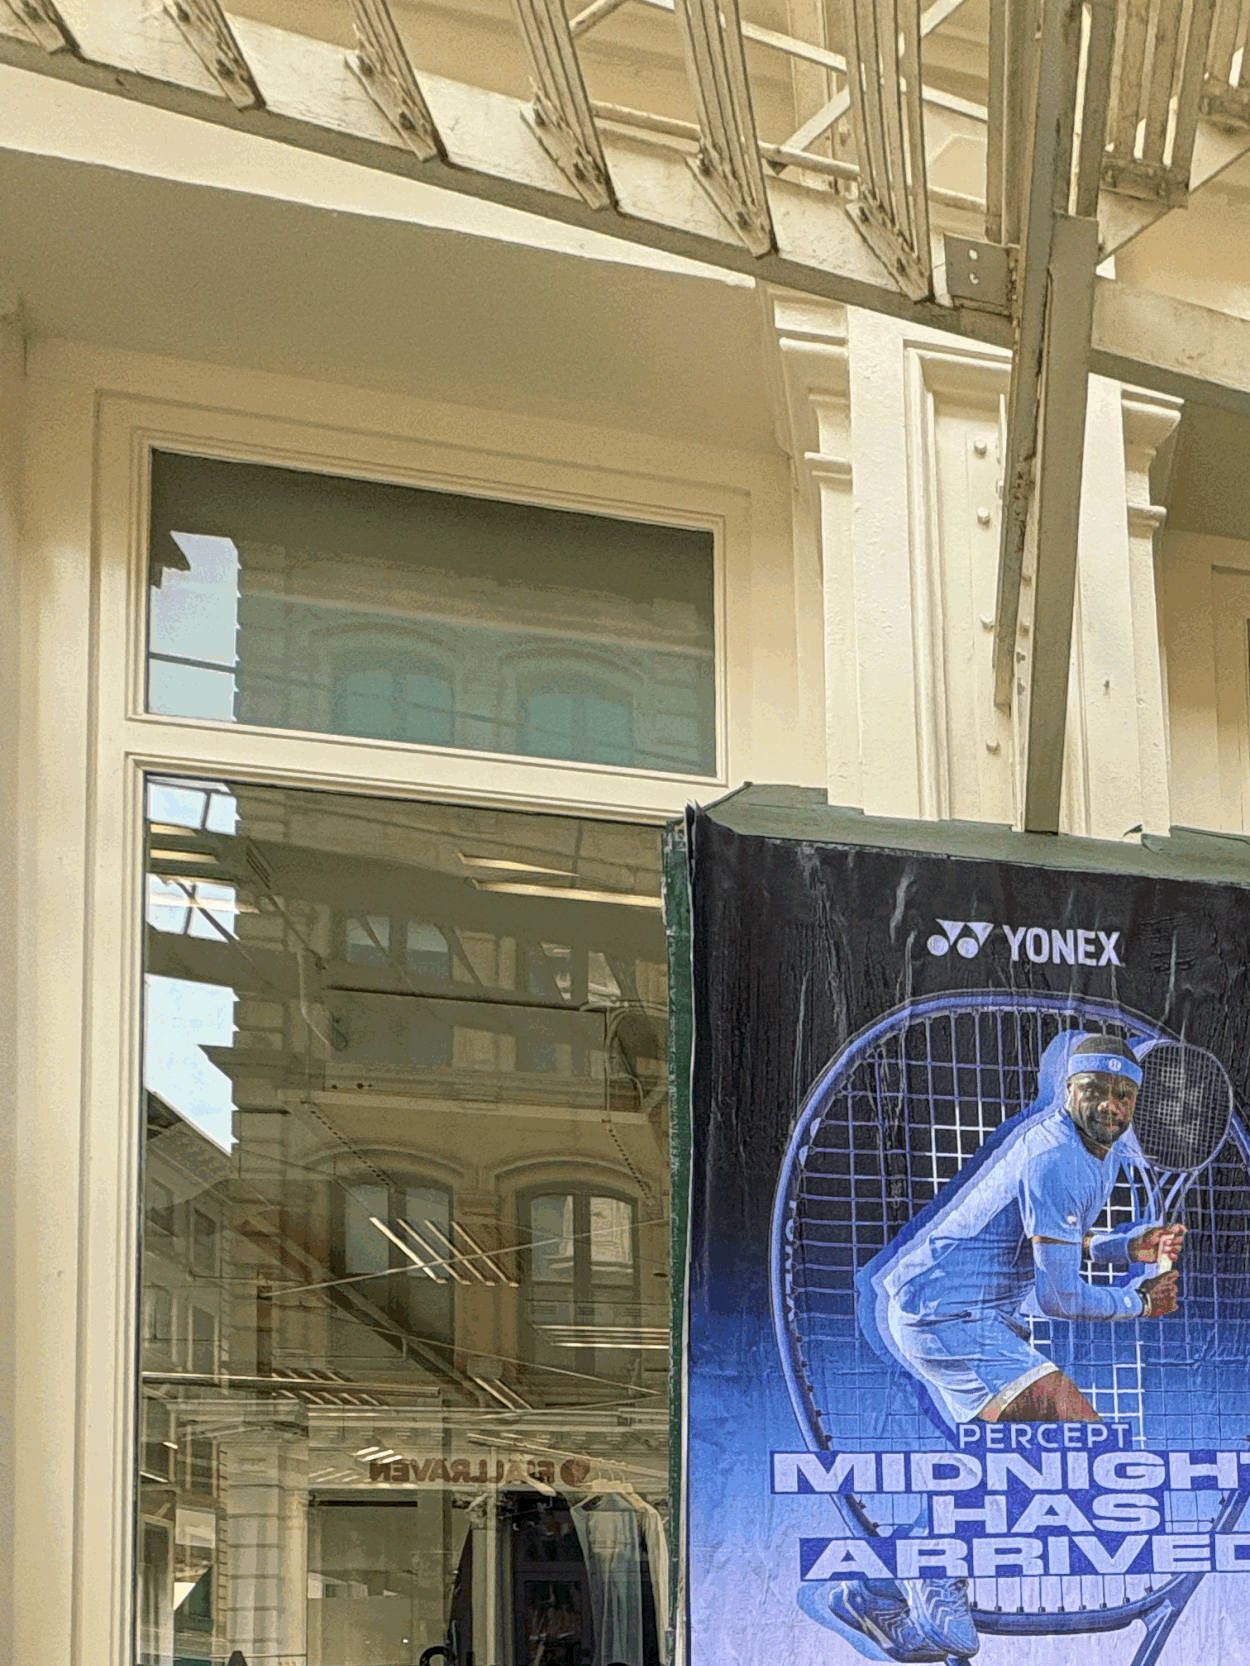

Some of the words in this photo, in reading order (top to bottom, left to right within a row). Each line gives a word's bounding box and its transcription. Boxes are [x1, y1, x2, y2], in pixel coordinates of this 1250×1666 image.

[1002, 924, 1123, 967] YONEX
[959, 1424, 1131, 1449] PERCEPT
[934, 1493, 1161, 1534] HAS
